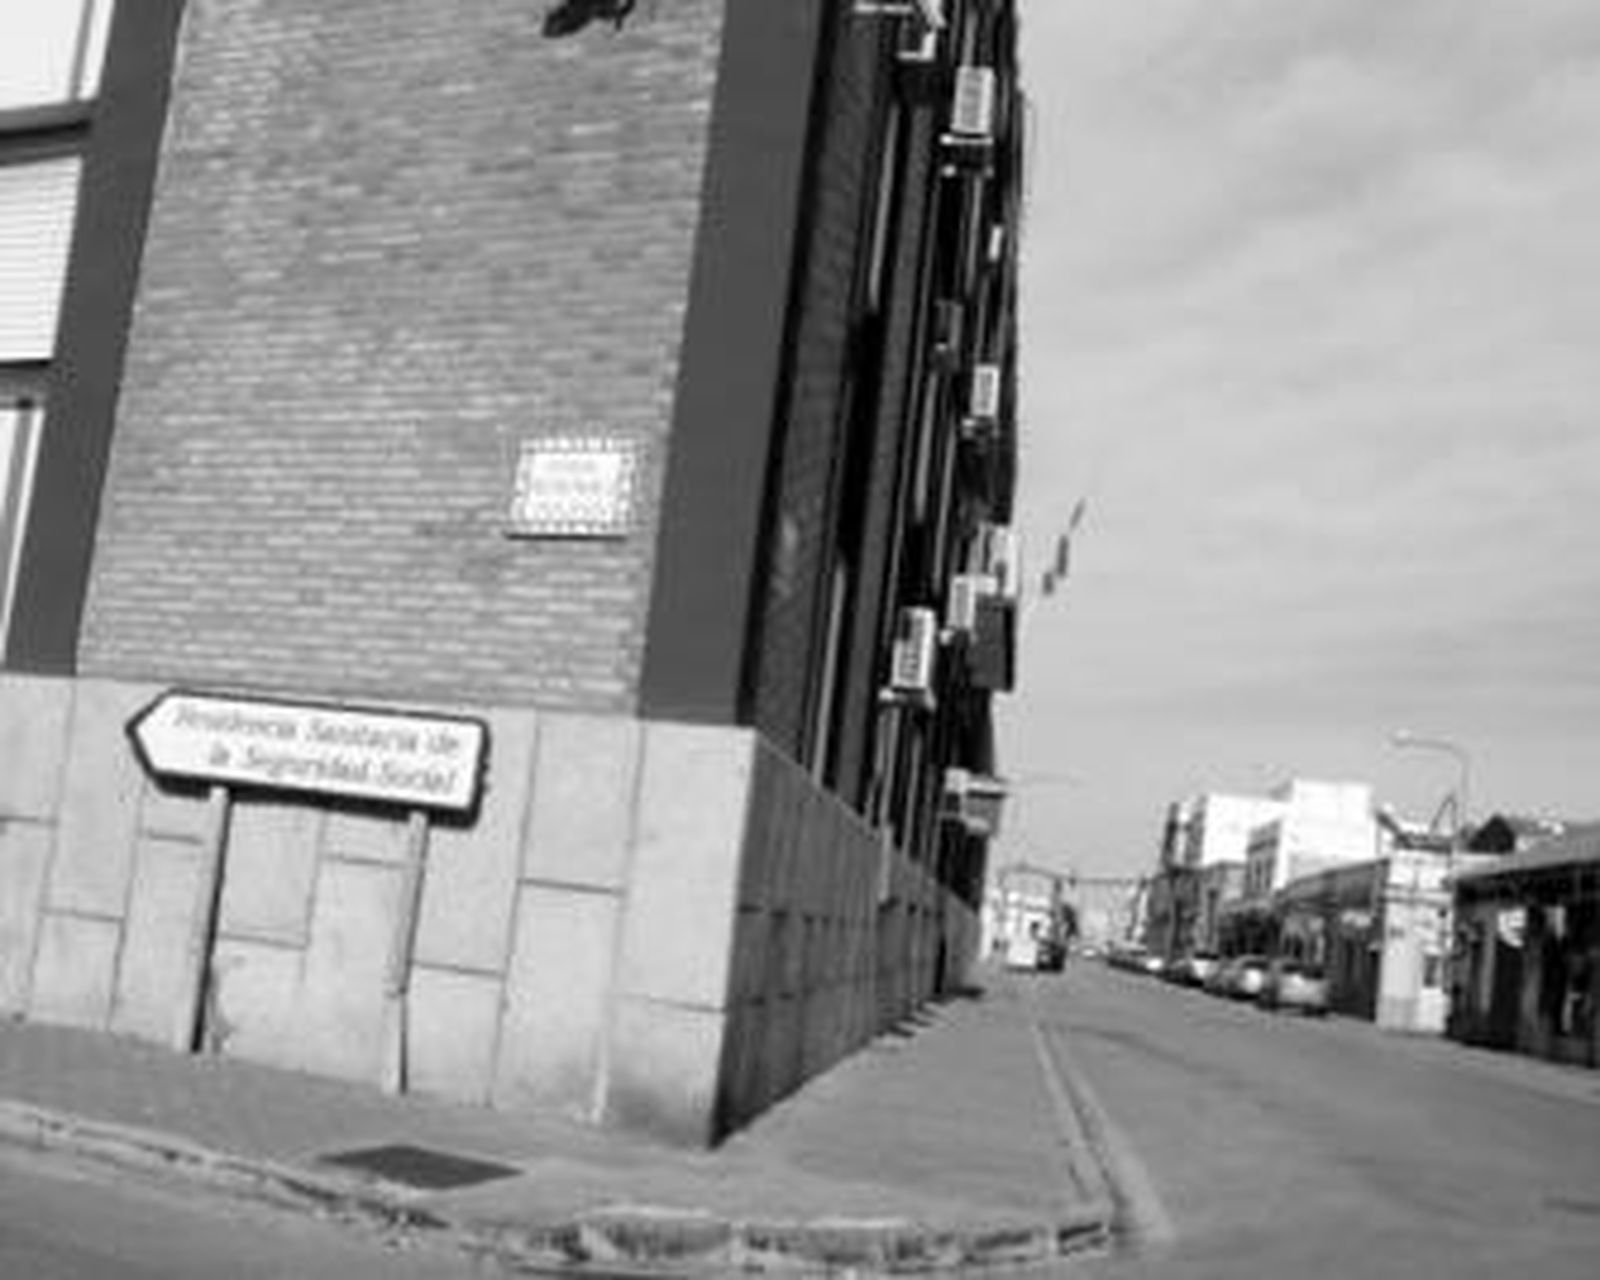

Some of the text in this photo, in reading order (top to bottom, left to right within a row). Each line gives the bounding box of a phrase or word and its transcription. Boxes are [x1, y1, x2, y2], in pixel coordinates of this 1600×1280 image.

[427, 725, 460, 755] de
[243, 745, 371, 784] Seguridad
[377, 759, 458, 796] Social
